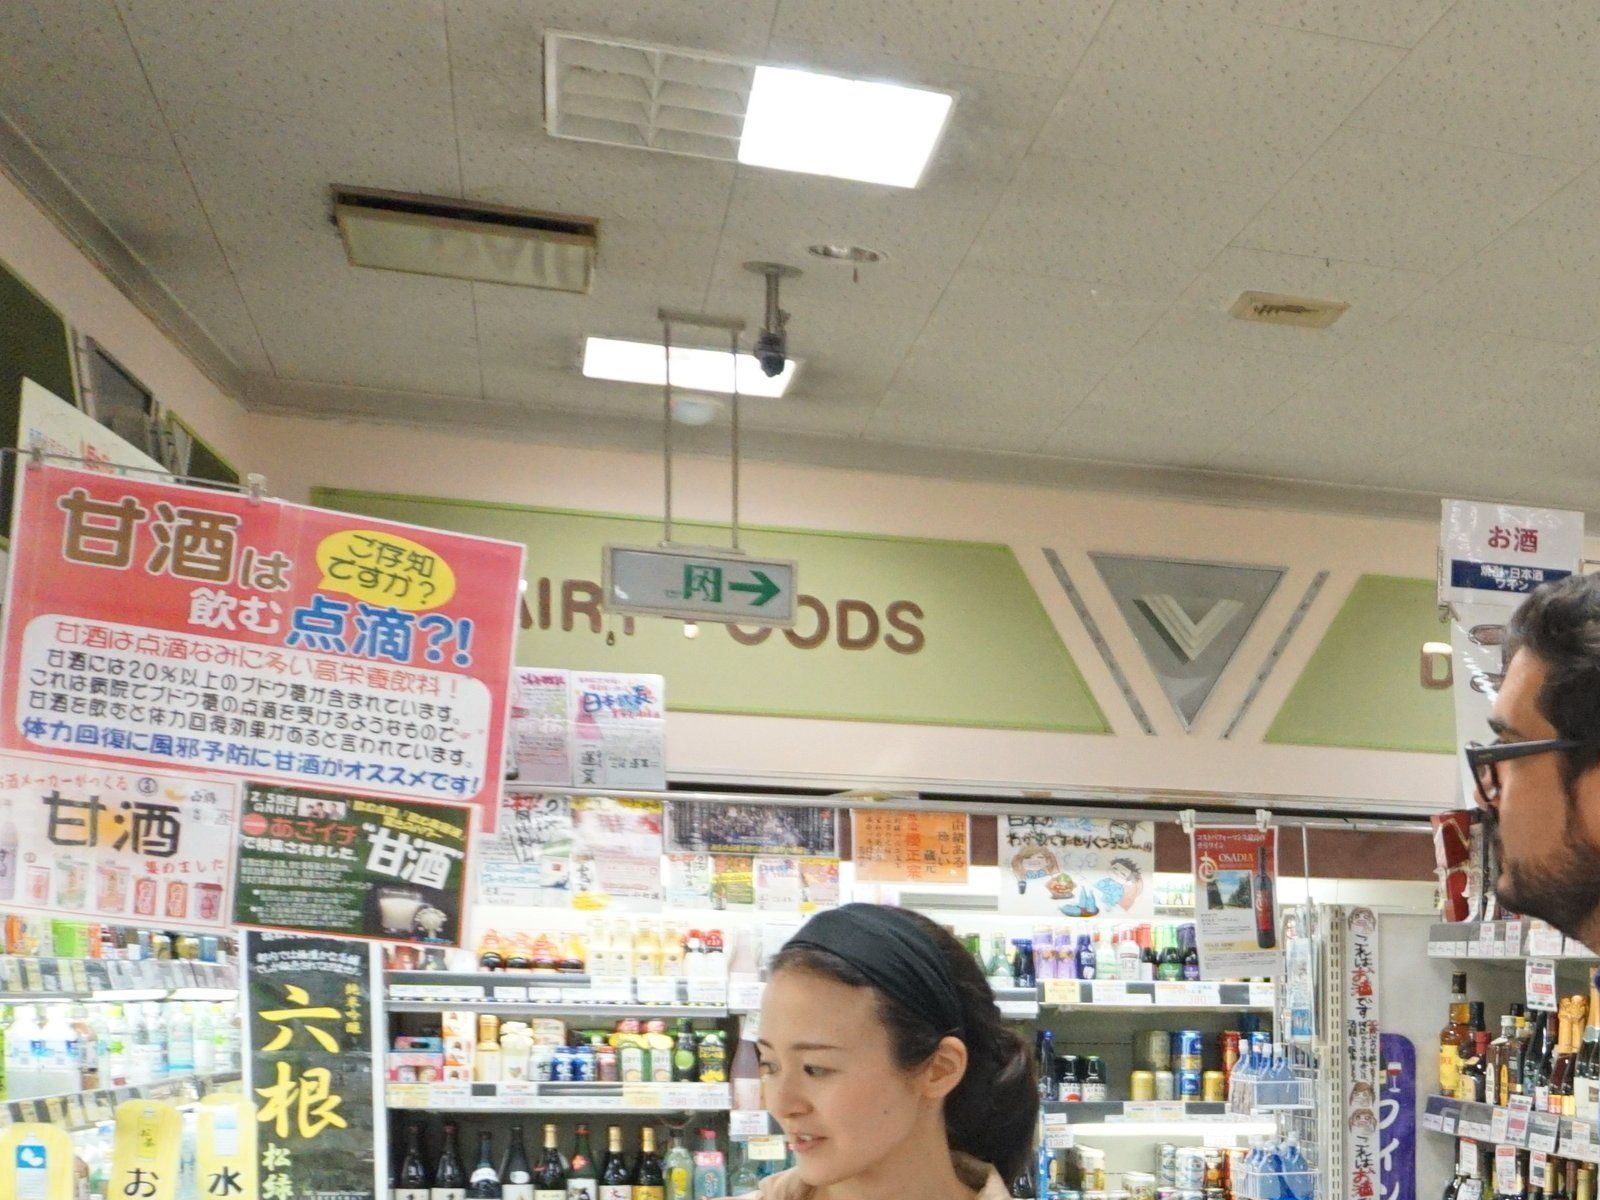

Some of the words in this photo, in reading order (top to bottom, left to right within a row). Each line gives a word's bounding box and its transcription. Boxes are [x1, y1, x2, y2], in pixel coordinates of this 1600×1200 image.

[59, 487, 291, 591] 甘酒は
[348, 534, 436, 578] ご存知
[1487, 526, 1539, 554] お酒
[41, 790, 181, 858] 甘酒
[256, 983, 349, 1138] 六根
[208, 1166, 244, 1198] 水
